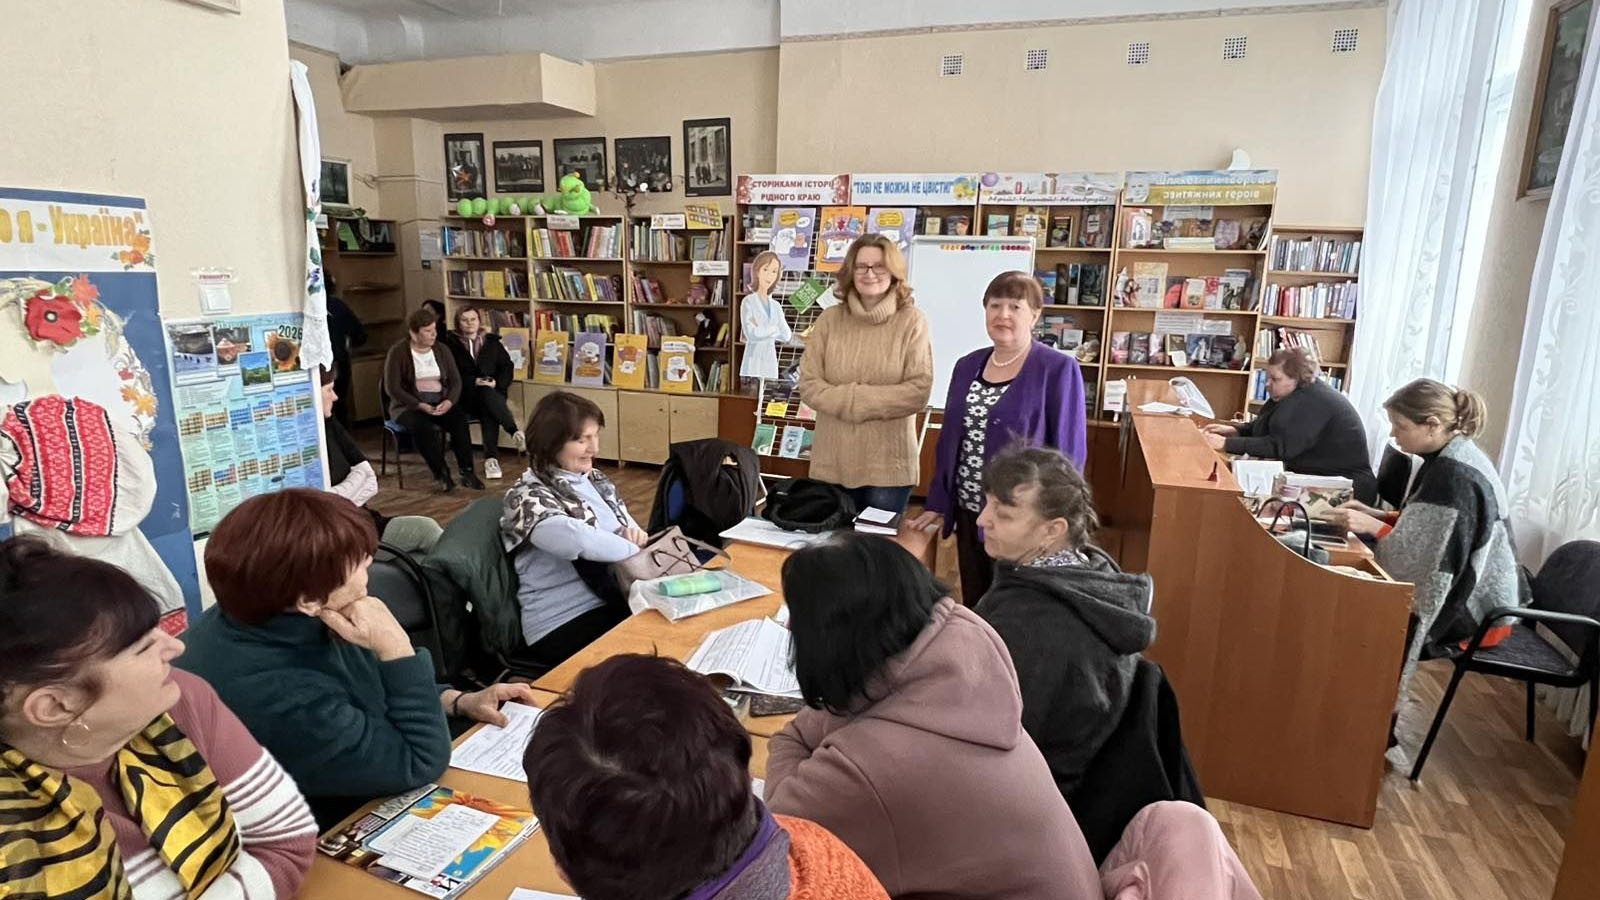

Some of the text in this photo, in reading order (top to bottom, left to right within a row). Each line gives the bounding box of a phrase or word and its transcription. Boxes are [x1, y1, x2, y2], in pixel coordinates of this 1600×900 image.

[752, 180, 803, 188] СТОРІНКАМИ
[873, 181, 883, 194] НЕ
[884, 181, 910, 194] МОЖНА
[911, 181, 922, 194] НЕ
[760, 193, 821, 202] РІДНОГО КРАЮ
[279, 324, 303, 340] 2026
